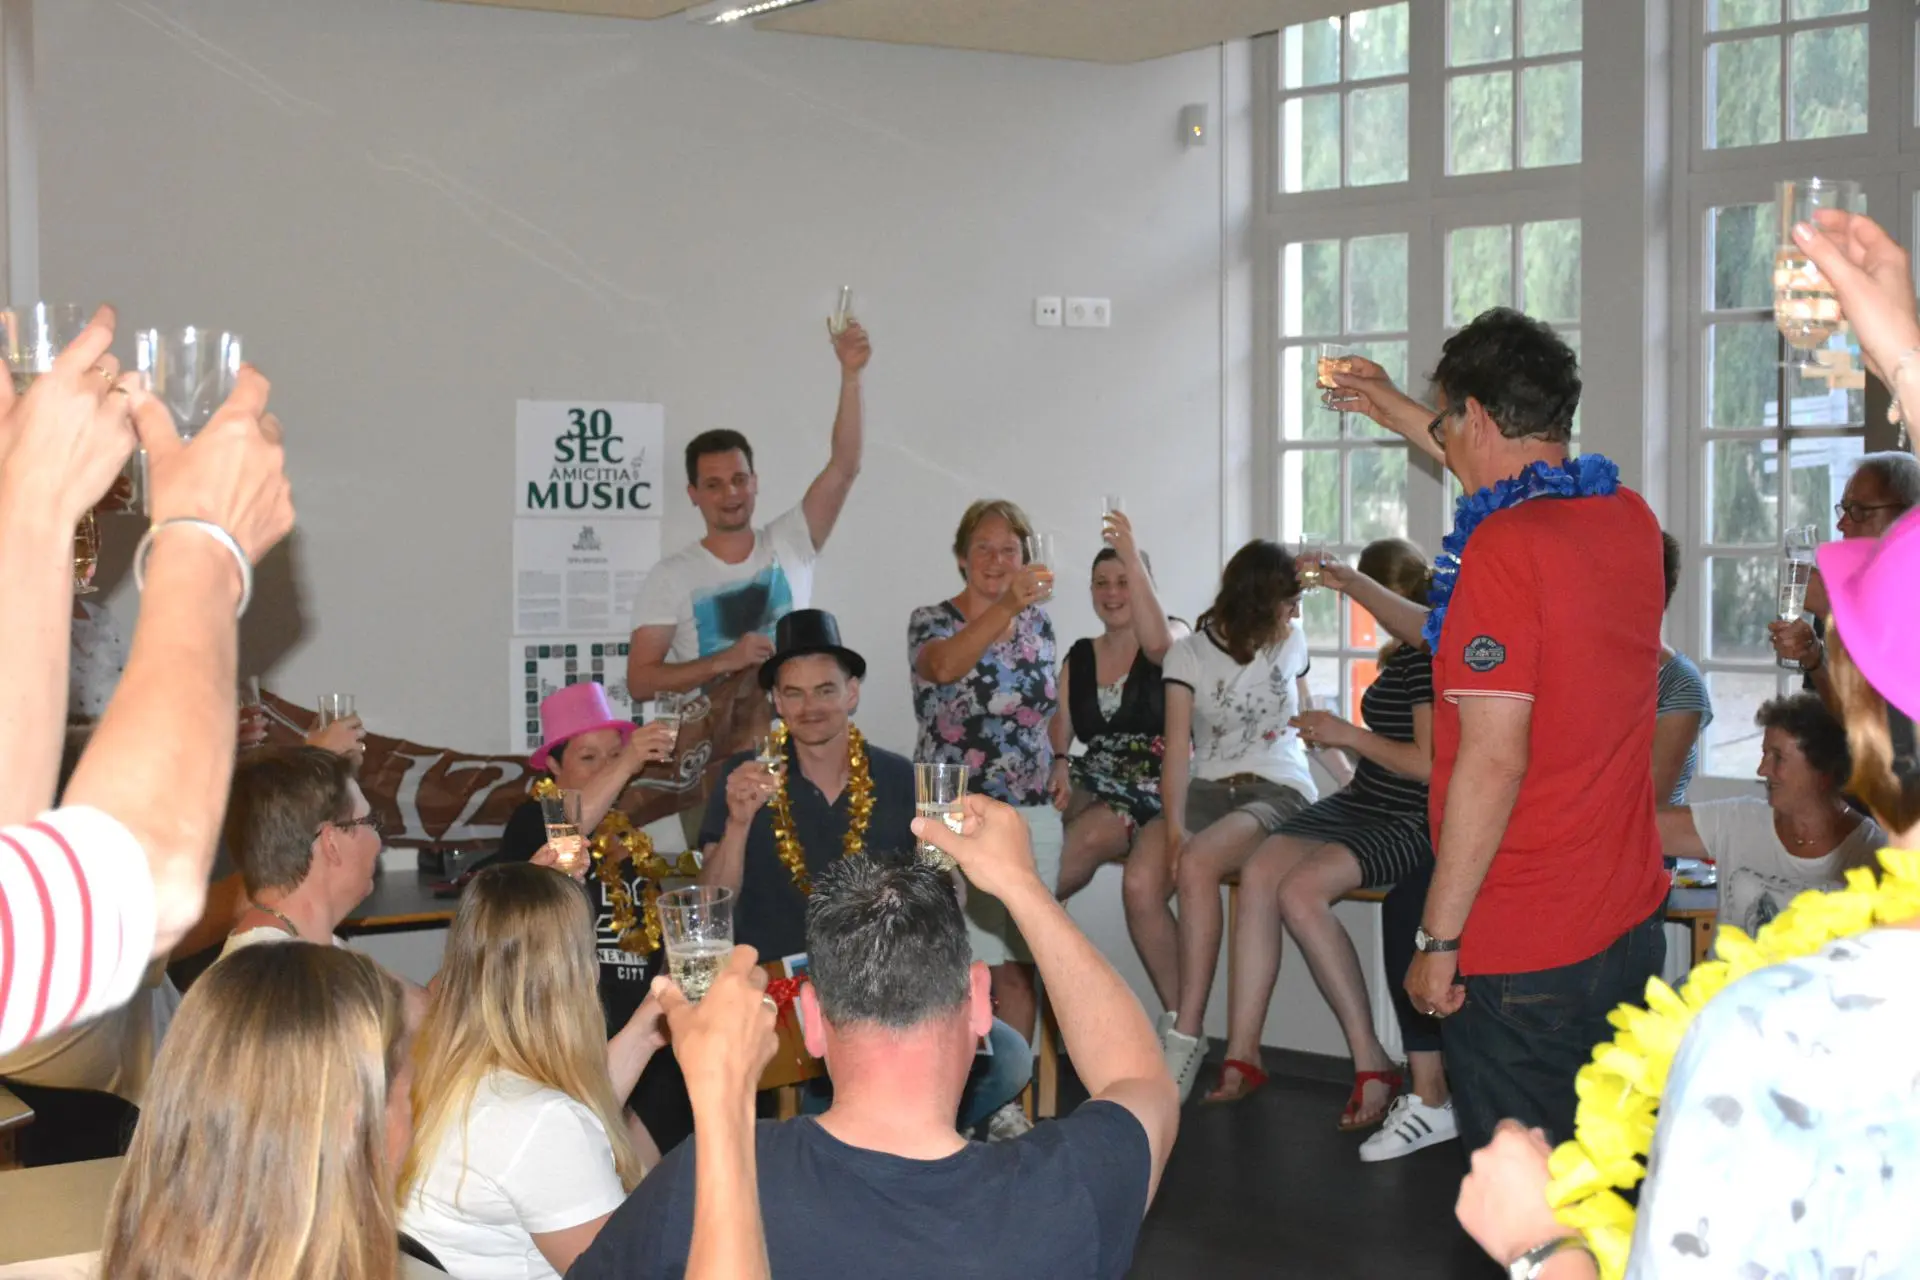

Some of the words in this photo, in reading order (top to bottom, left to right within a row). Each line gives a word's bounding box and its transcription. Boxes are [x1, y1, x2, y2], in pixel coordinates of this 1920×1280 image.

[567, 408, 612, 440] 30
[554, 436, 624, 464] SEC
[549, 468, 630, 481] AMICITIA
[527, 481, 652, 510] MUSIC
[617, 966, 645, 981] CITY
